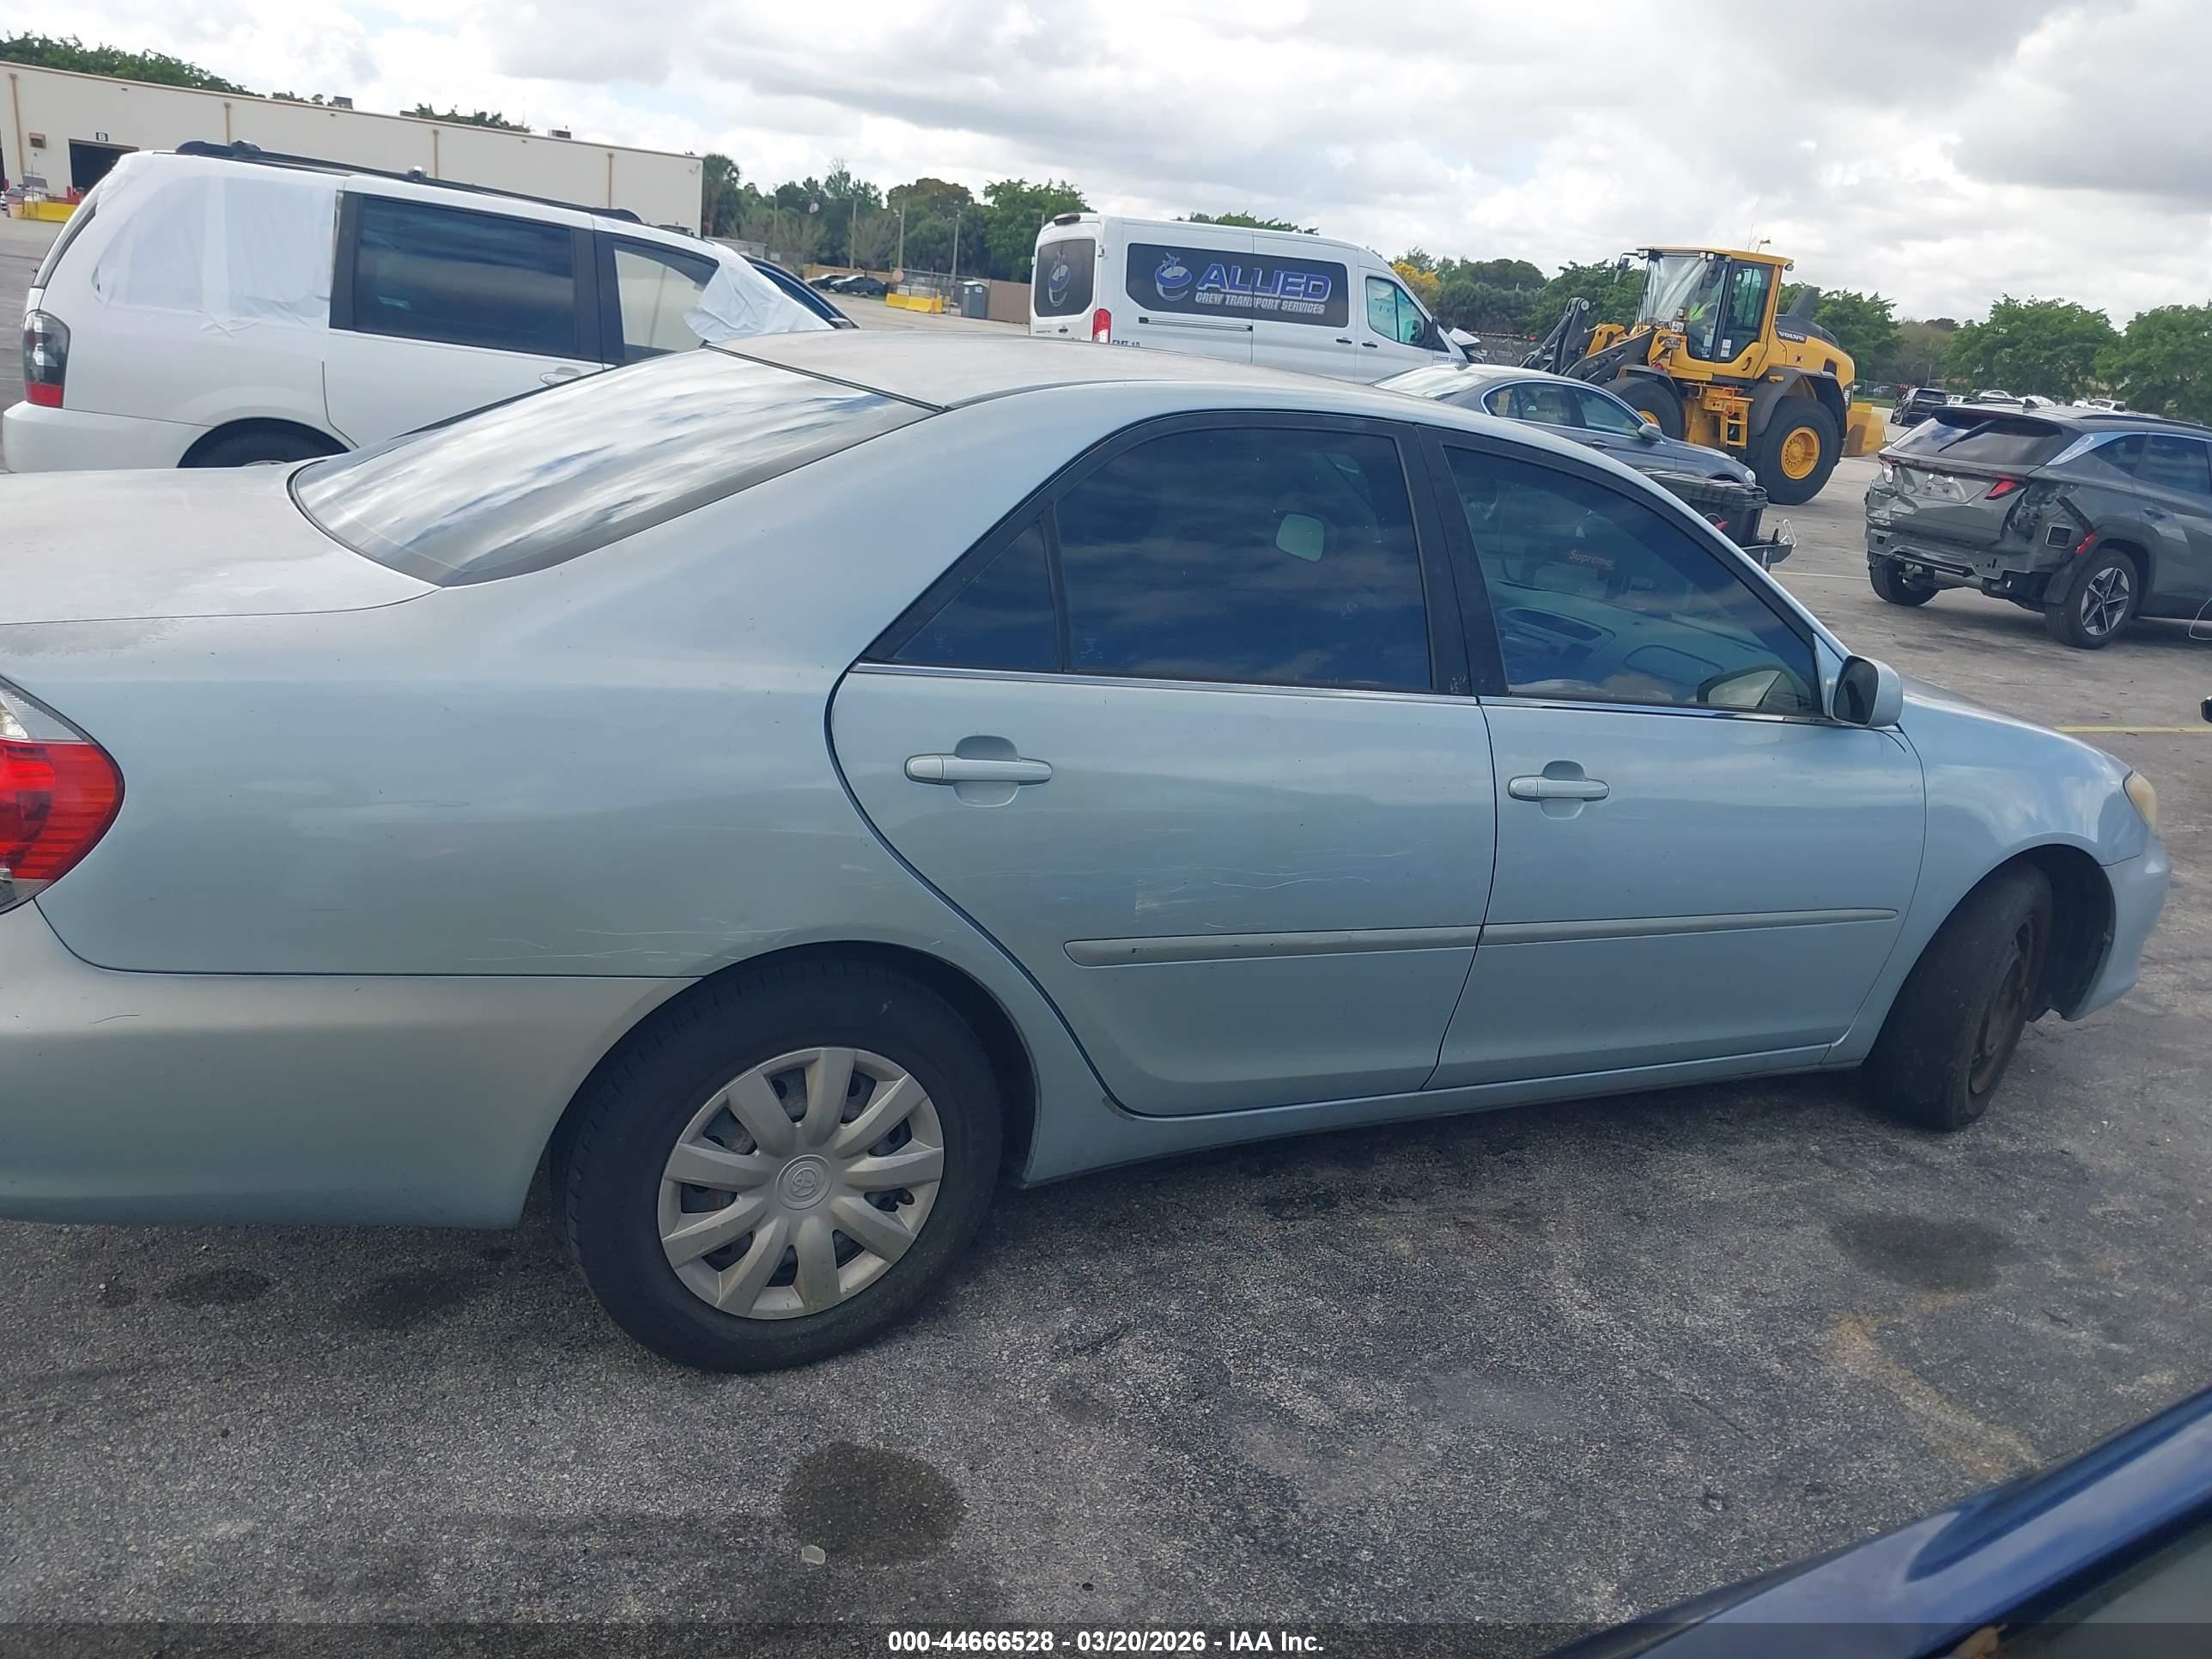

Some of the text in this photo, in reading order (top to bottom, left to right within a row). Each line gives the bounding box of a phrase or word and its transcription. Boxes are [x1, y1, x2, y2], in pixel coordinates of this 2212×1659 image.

[1195, 263, 1332, 302] ALLIED
[1194, 291, 1326, 315] CREW TRANSPORT SERVICES
[1778, 331, 1805, 341] VOLVO
